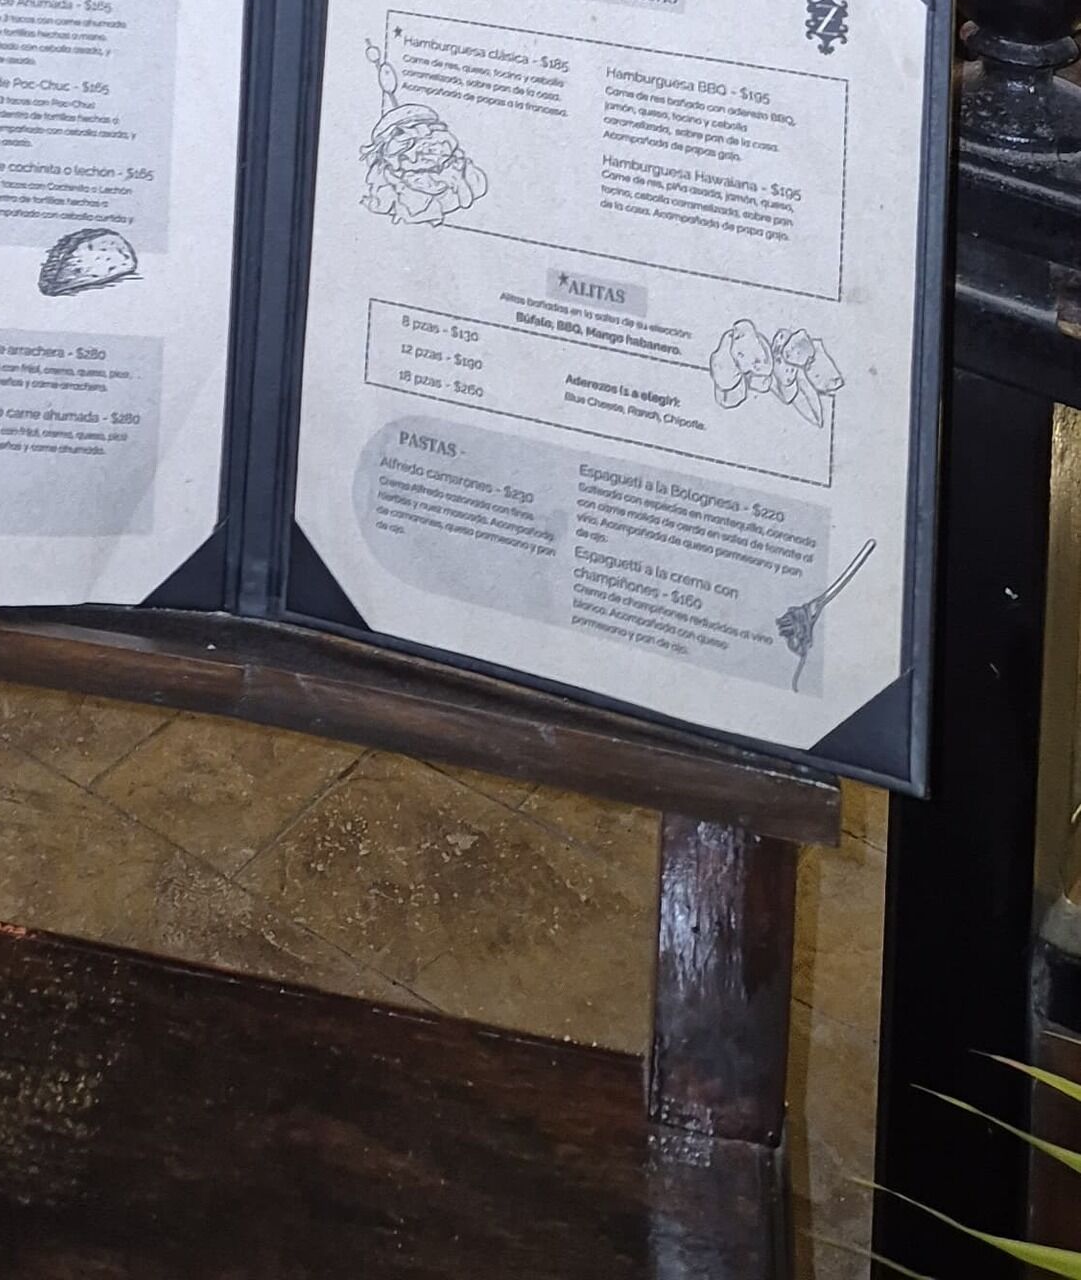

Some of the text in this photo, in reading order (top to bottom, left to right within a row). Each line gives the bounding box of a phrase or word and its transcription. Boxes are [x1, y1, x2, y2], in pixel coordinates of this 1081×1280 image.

[403, 36, 485, 57] Hamburguesa
[540, 56, 570, 72] $185
[13, 77, 70, 91] Poc-Chuc
[606, 67, 694, 91] Hamburguesa
[698, 81, 727, 95] BBQ
[739, 87, 770, 104] $195
[7, 162, 61, 174] cochinita
[62, 166, 72, 175] o
[602, 155, 691, 179] Hamburguesa
[695, 170, 758, 191] Hawaiana
[770, 184, 801, 201] $195
[568, 280, 625, 303] ALITAS
[401, 315, 410, 327] 8
[412, 320, 440, 333] pzas
[450, 325, 479, 342] $130
[516, 312, 554, 330] Búfalo,
[556, 320, 583, 335] BBQ,
[625, 334, 682, 355] habanero.
[6, 346, 65, 358] arrachera
[401, 344, 413, 354] 12
[414, 347, 442, 361] pzas
[454, 353, 483, 370] $190
[399, 370, 411, 382] 18
[414, 374, 442, 388] pzas
[453, 380, 484, 397] $260
[565, 374, 618, 393] Aderezos
[631, 390, 639, 398] a
[5, 408, 41, 420] carne
[42, 409, 99, 423] ahumada
[399, 431, 456, 457] PASTAS
[379, 456, 425, 476] Alfredo
[426, 469, 493, 493] camarones
[503, 485, 534, 503] $230
[645, 481, 653, 491] a
[655, 481, 668, 494] la
[670, 485, 740, 511] Bolognesa
[752, 504, 785, 522] $220
[644, 565, 653, 575] a
[655, 567, 668, 580] la
[669, 573, 711, 591] crema
[714, 584, 738, 599] con
[671, 591, 702, 609] $160
